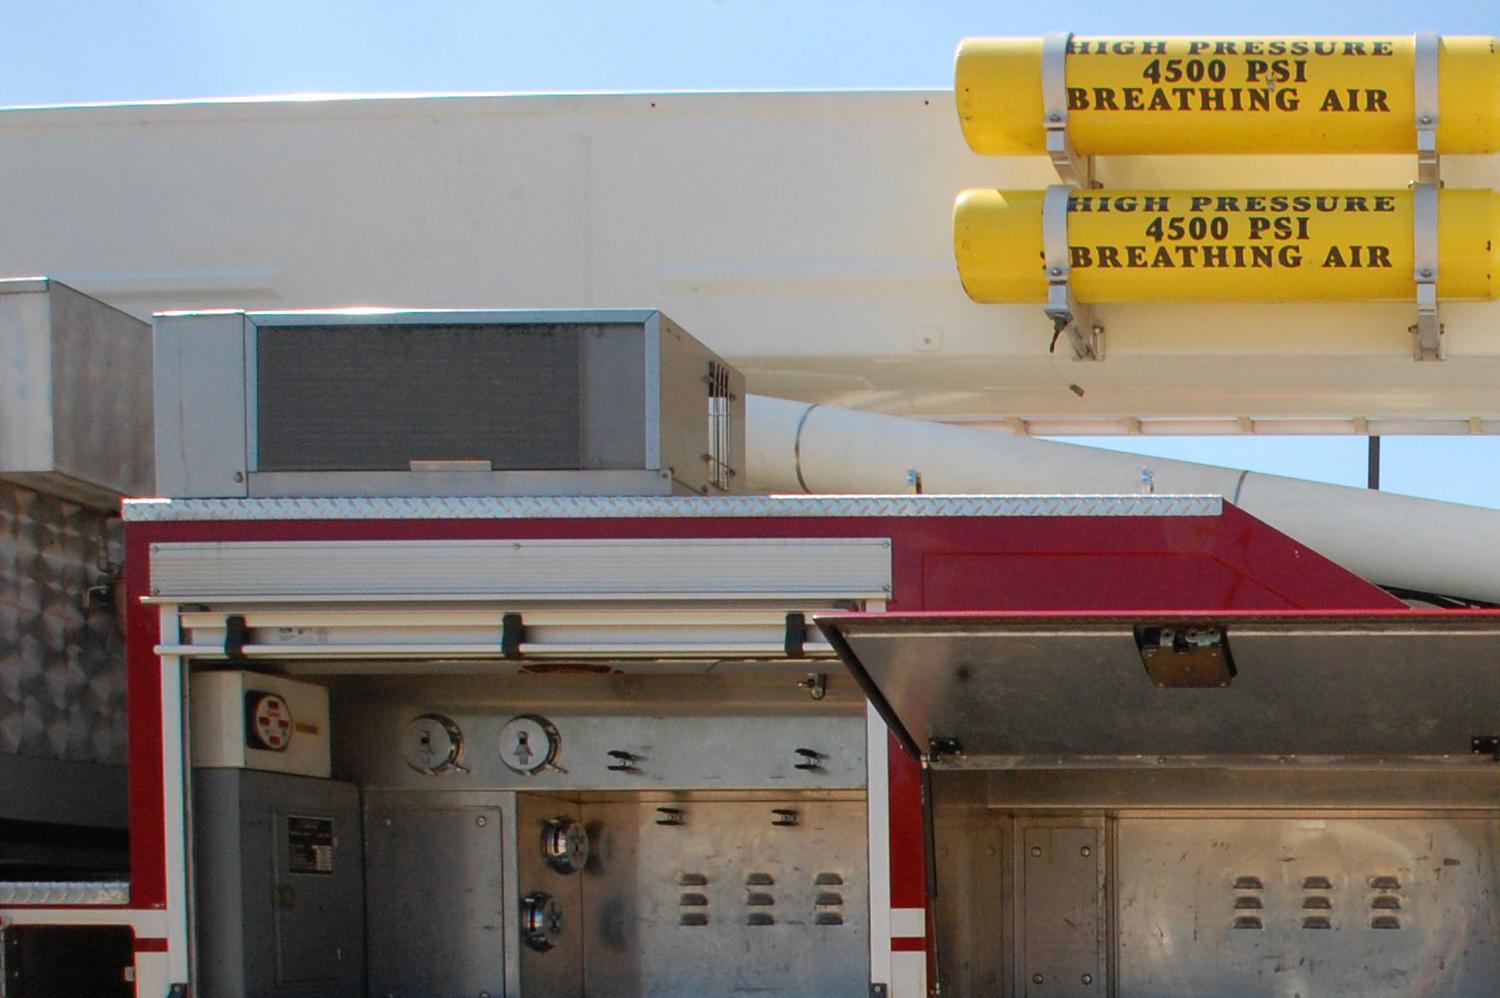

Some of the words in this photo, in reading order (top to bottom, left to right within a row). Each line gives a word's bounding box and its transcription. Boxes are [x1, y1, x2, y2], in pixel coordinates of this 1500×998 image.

[1067, 41, 1168, 55] HIGH
[1188, 41, 1393, 56] PRESSURE
[1143, 59, 1226, 84] 4500
[1246, 59, 1307, 82] PSI
[1066, 87, 1300, 112] BREATHING
[1319, 89, 1390, 112] AIR
[1068, 196, 1170, 212] HIGH
[1189, 196, 1395, 212] PRESSURE
[1145, 216, 1229, 242] 4500
[1248, 216, 1310, 240] PSI
[1069, 245, 1303, 268] BREATHING
[1322, 245, 1392, 268] AIR
